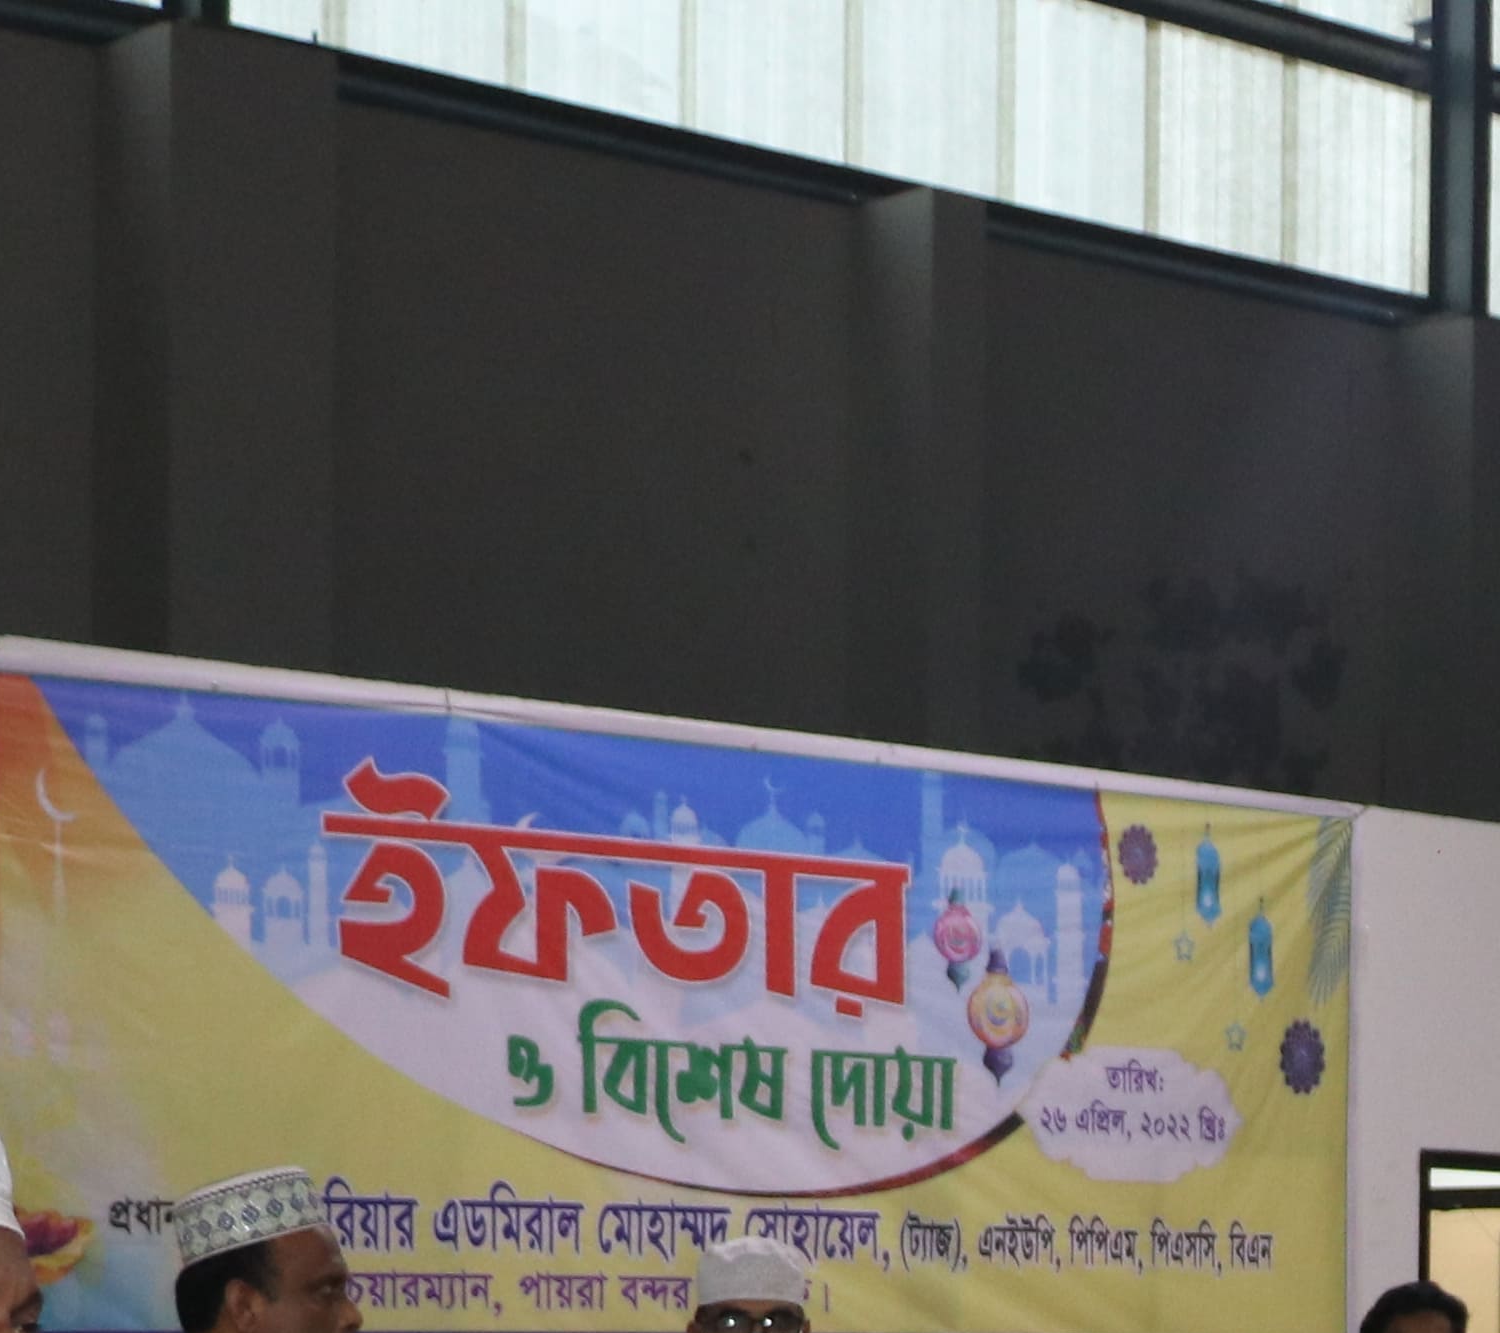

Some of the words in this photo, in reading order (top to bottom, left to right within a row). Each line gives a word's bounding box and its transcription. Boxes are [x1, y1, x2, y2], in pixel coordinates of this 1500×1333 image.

[322, 757, 911, 1018] ইফতার
[507, 1034, 554, 1108] ও
[577, 1000, 789, 1144] বিশেষ
[811, 1047, 957, 1150] দোয়া
[1040, 1106, 1067, 1136] ২৬
[1075, 1099, 1132, 1142] এপ্রিল,
[1140, 1112, 1192, 1141] ২০২২
[109, 1196, 174, 1235] প্রধা
[323, 1177, 419, 1252] রিয়ার
[433, 1181, 584, 1254] এডমিরাল
[599, 1198, 732, 1263] মোহাম্মদ
[978, 1213, 1062, 1273] এনইউপি,
[1068, 1213, 1144, 1276] পিপিএম,
[1148, 1216, 1223, 1278] পিএসসি,
[1228, 1217, 1273, 1270] বিএন
[518, 1270, 606, 1310] পায়রা
[619, 1276, 693, 1310] বন্দর
